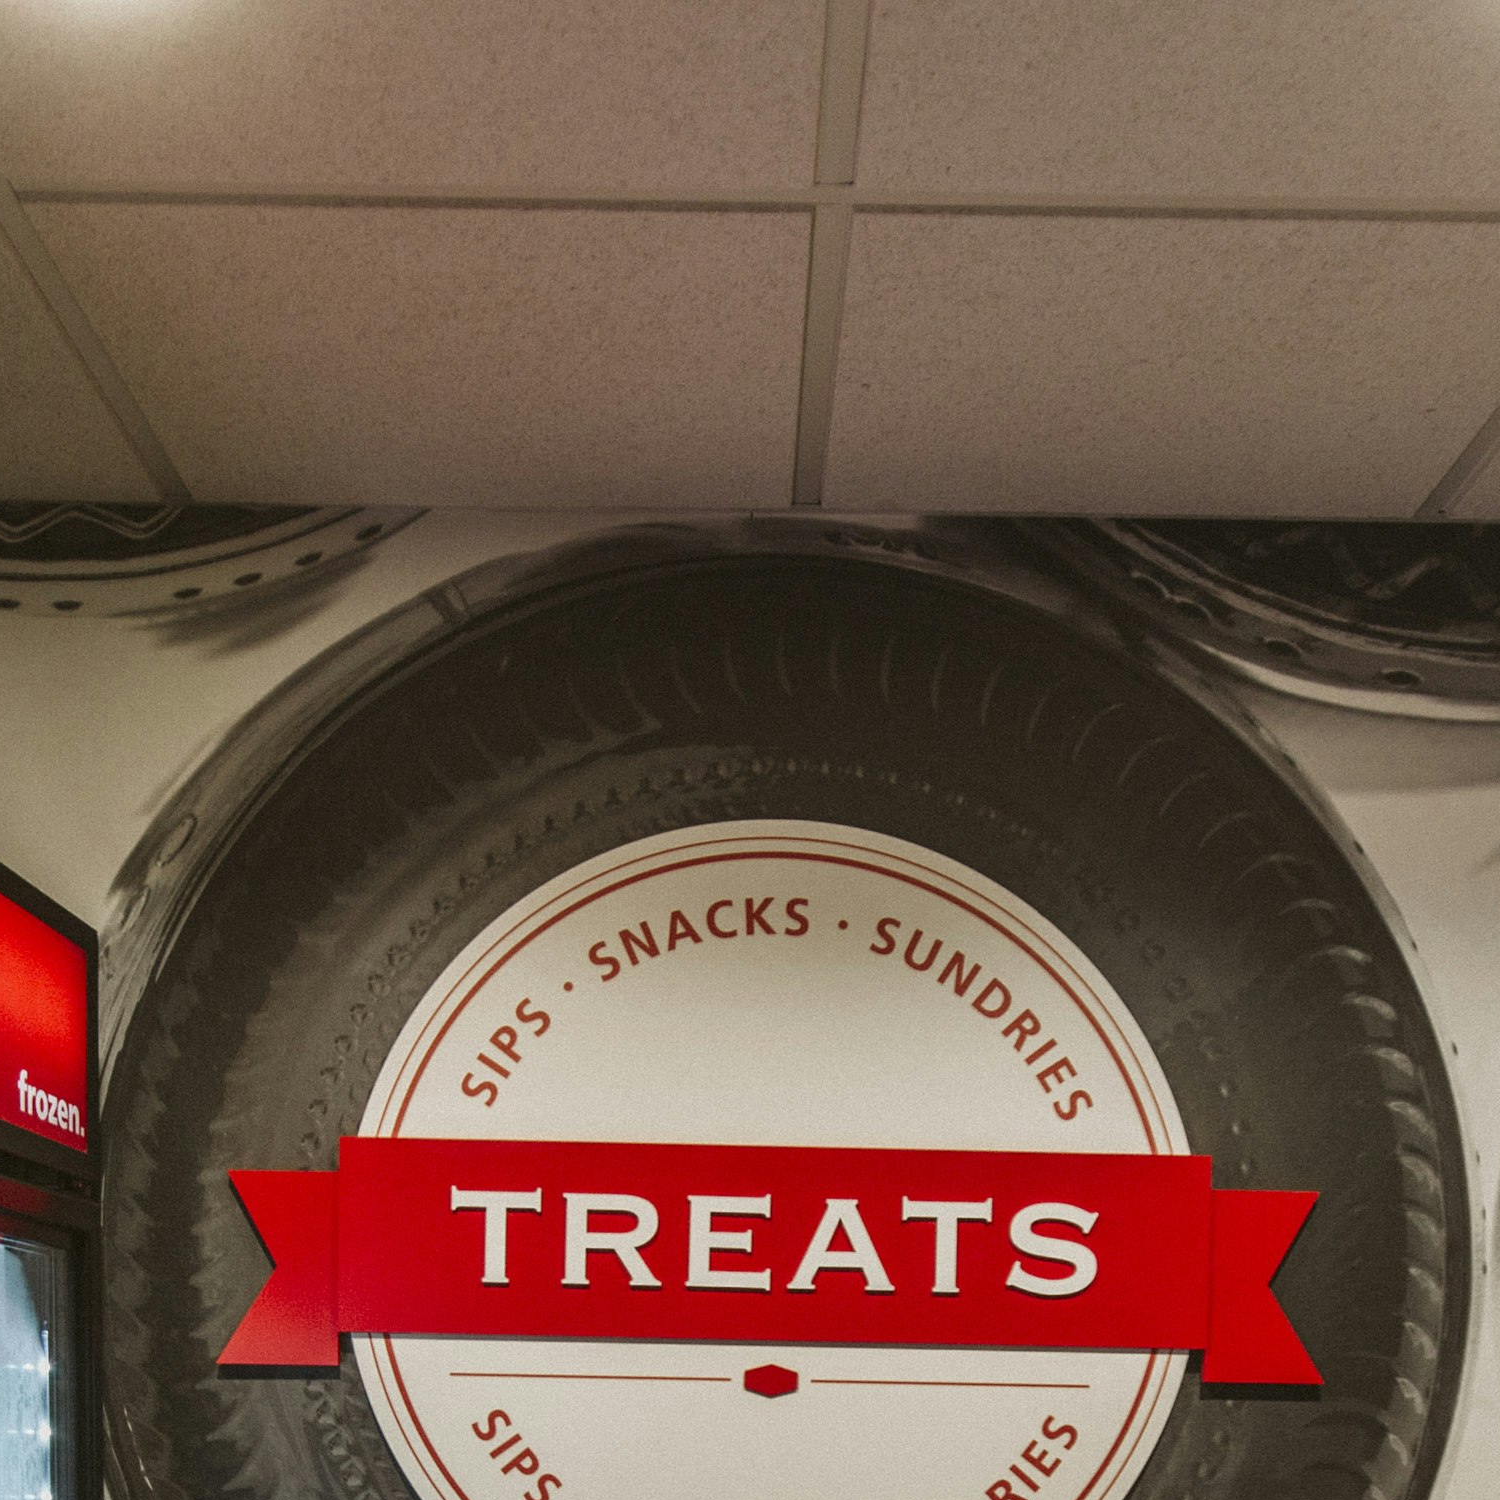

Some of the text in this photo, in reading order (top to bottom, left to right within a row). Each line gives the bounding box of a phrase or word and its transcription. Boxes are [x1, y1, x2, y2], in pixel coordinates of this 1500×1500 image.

[460, 896, 1093, 1121] SIPS SNACKS SUNDRIES
[17, 1068, 85, 1137] frozen.
[450, 1184, 1100, 1297] TREATS
